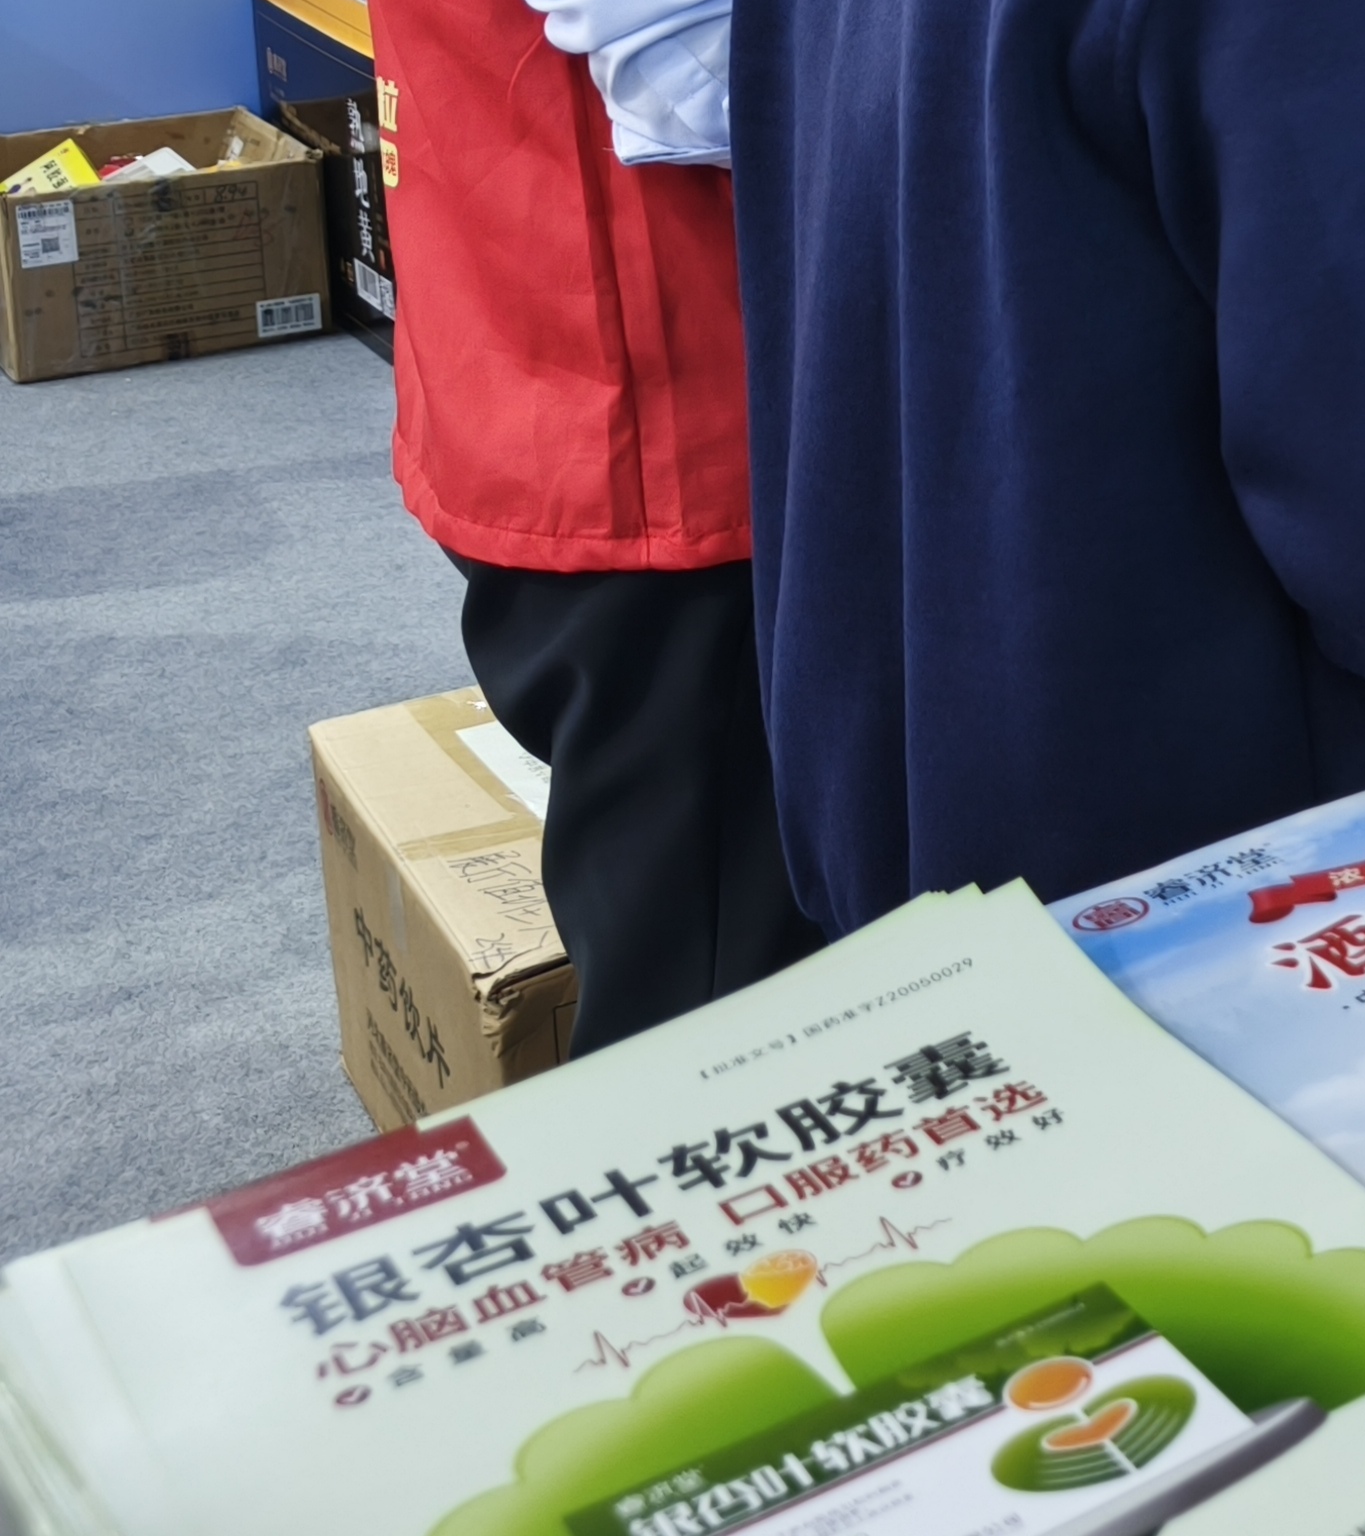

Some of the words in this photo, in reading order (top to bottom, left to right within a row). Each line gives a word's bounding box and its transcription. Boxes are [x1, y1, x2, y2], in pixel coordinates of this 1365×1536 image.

[353, 905, 451, 1090] 中药饮片
[254, 1146, 466, 1246] 睿济堂
[279, 1030, 1011, 1336] 银杏叶软胶囊
[316, 1223, 691, 1381] 心脑血管病
[717, 1080, 1049, 1227] 口服药首选
[669, 1210, 815, 1284] 起效快
[935, 1106, 1066, 1174] 疗效好
[627, 1373, 995, 1536] 银杏叶软胶囊
